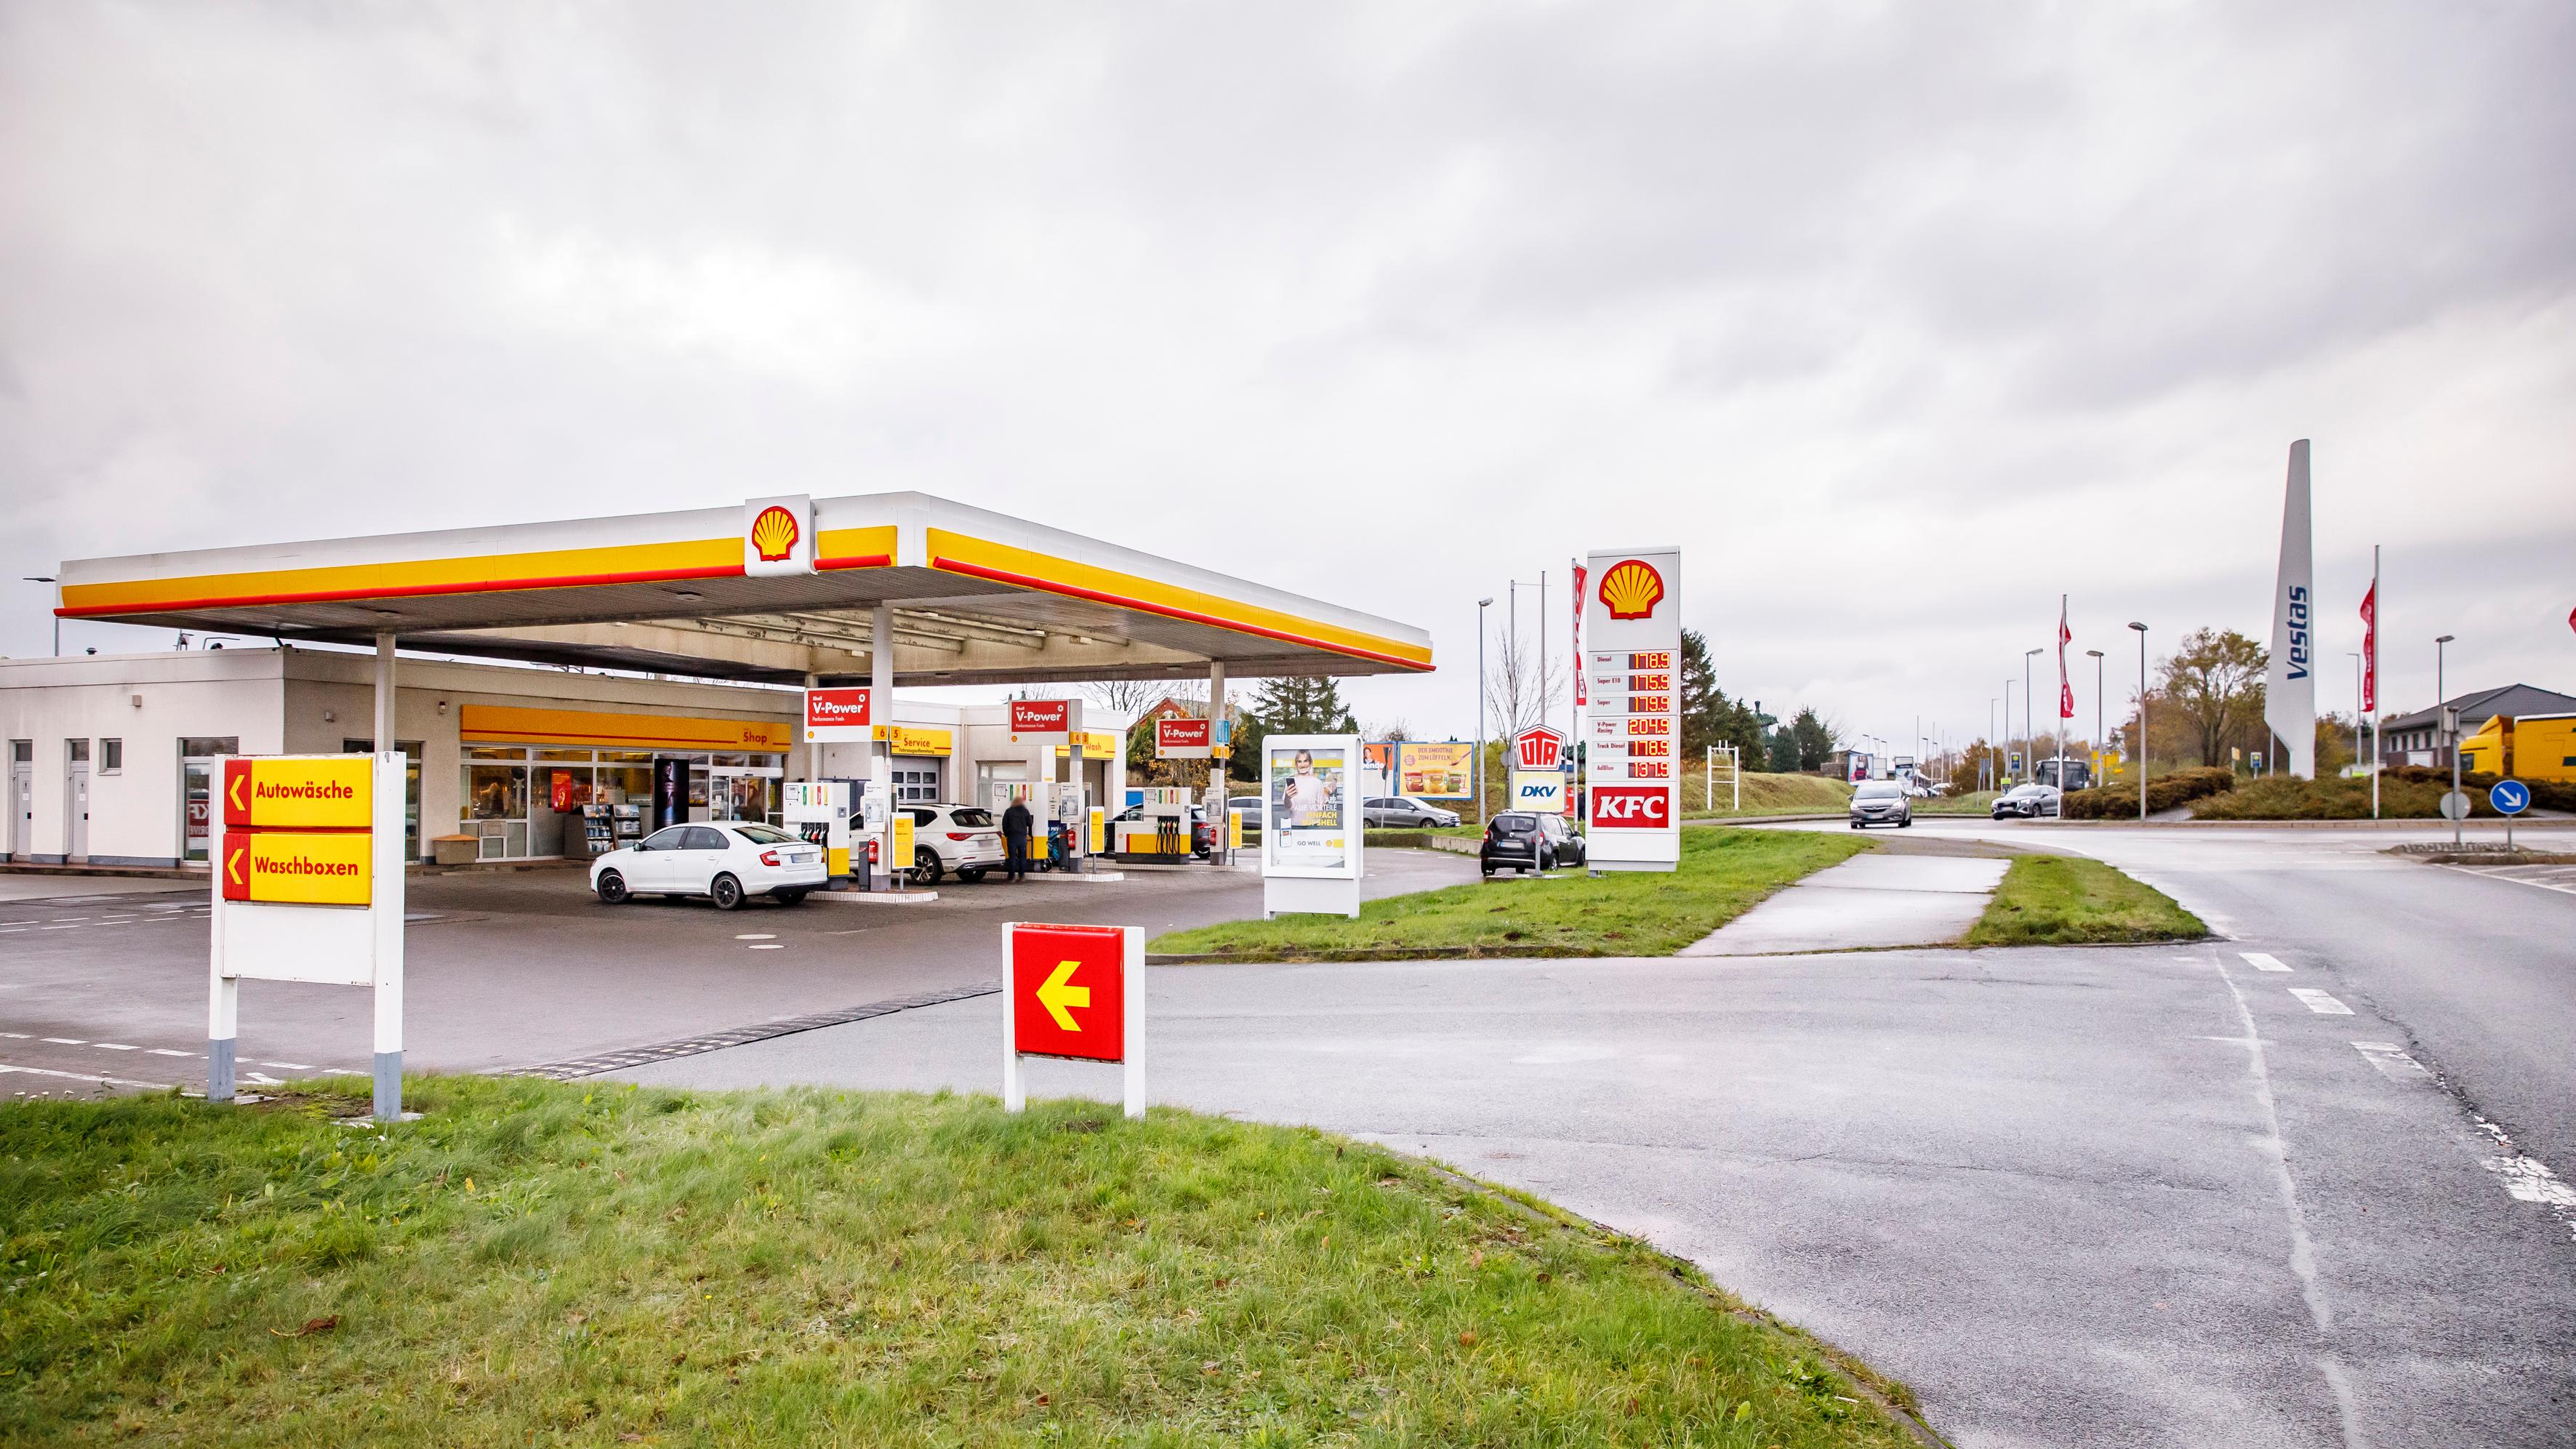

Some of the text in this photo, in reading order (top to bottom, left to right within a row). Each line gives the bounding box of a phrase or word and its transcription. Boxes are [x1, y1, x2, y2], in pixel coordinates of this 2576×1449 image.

[2287, 585, 2308, 681] Vestas
[1634, 653, 1669, 668] 178.9
[1634, 675, 1669, 690] 175.9
[813, 702, 864, 714] V-Power
[1634, 696, 1669, 712] 179.9
[1016, 712, 1062, 721] V-Power
[880, 728, 885, 737] 6
[894, 729, 899, 738] 5
[1163, 729, 1204, 738] V-Power
[1629, 718, 1669, 734] 204.9
[743, 730, 768, 746] Shop
[904, 737, 931, 747] Service
[1086, 742, 1102, 751] Wash
[1520, 730, 1560, 766] UTA
[1634, 740, 1669, 755] 178.9
[1634, 762, 1669, 777] 137.9
[256, 780, 353, 798] Autowäsche
[1521, 786, 1557, 797] DKV
[1597, 795, 1665, 819] KFC
[254, 856, 358, 875] Waschboxen
